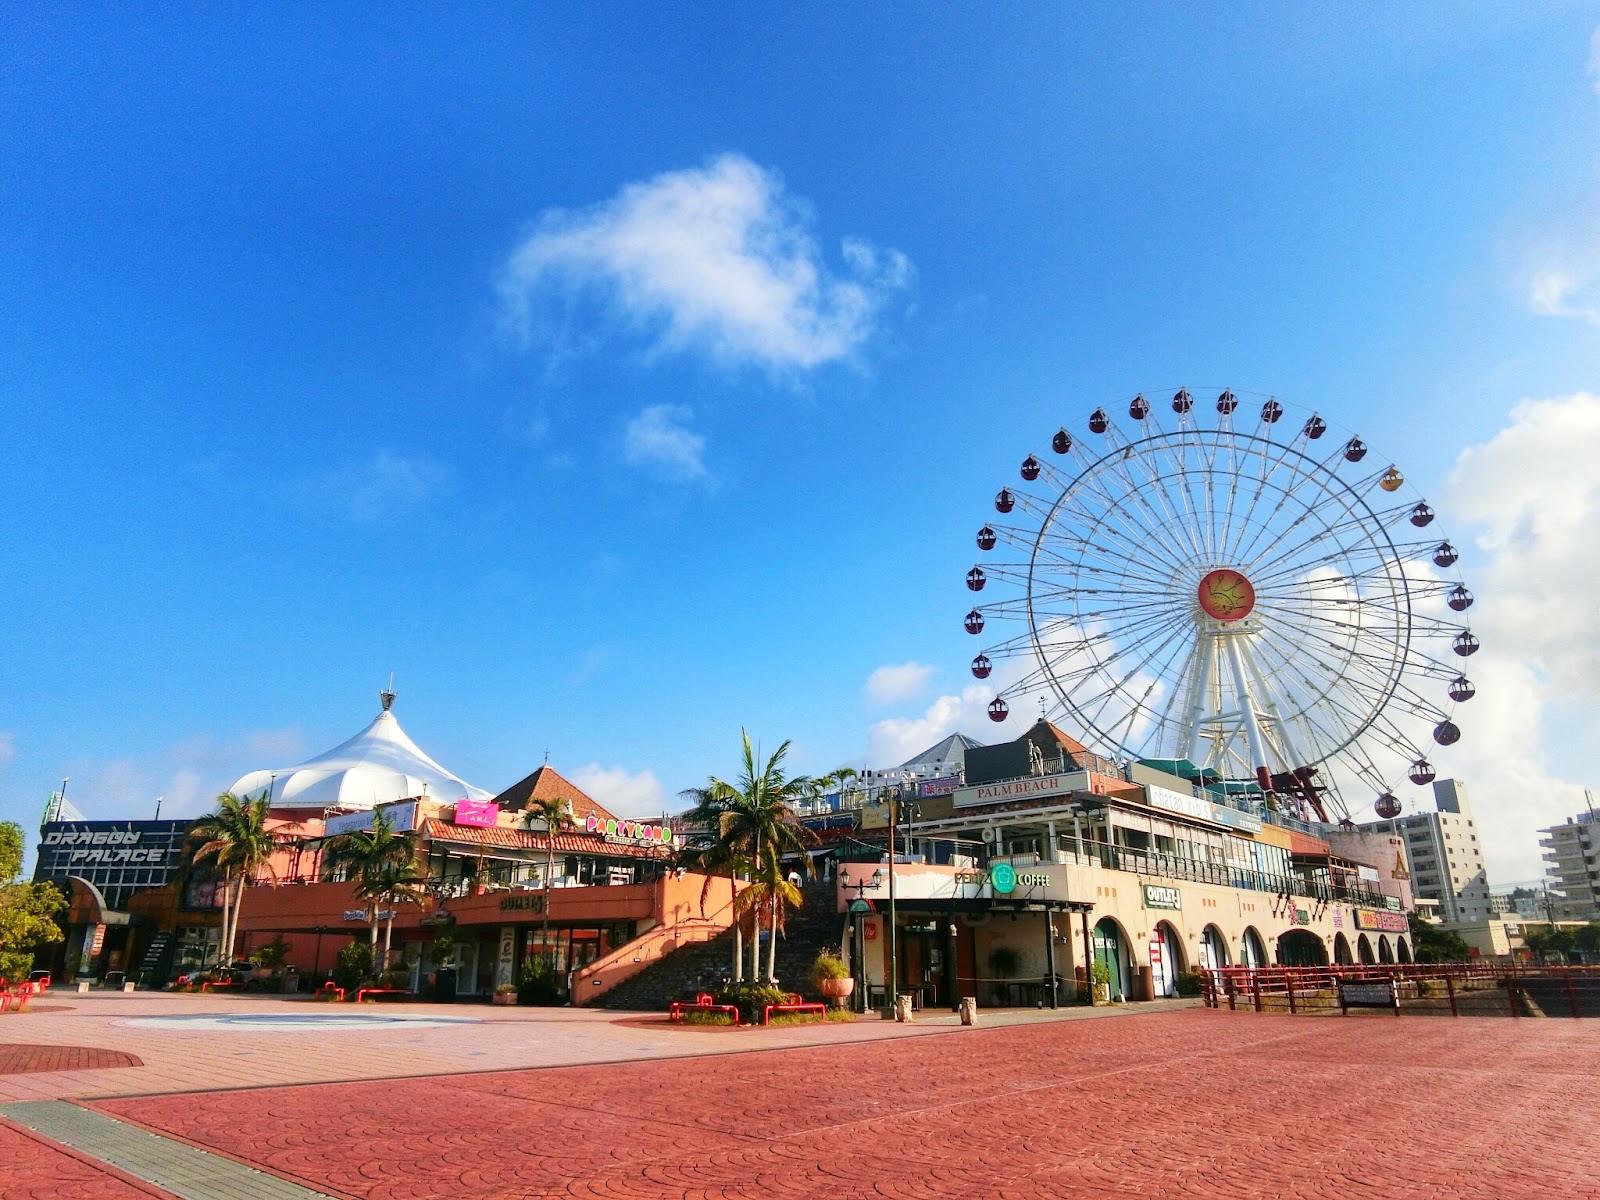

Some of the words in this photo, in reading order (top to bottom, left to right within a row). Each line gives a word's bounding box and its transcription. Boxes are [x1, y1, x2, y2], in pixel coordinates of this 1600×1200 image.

[977, 785, 1012, 799] PALM
[1015, 778, 1059, 793] BEACH
[587, 816, 671, 843] PARTYLAND
[43, 831, 142, 845] DRAGON
[71, 848, 165, 862] PALACE
[1018, 873, 1051, 887] COFFEE
